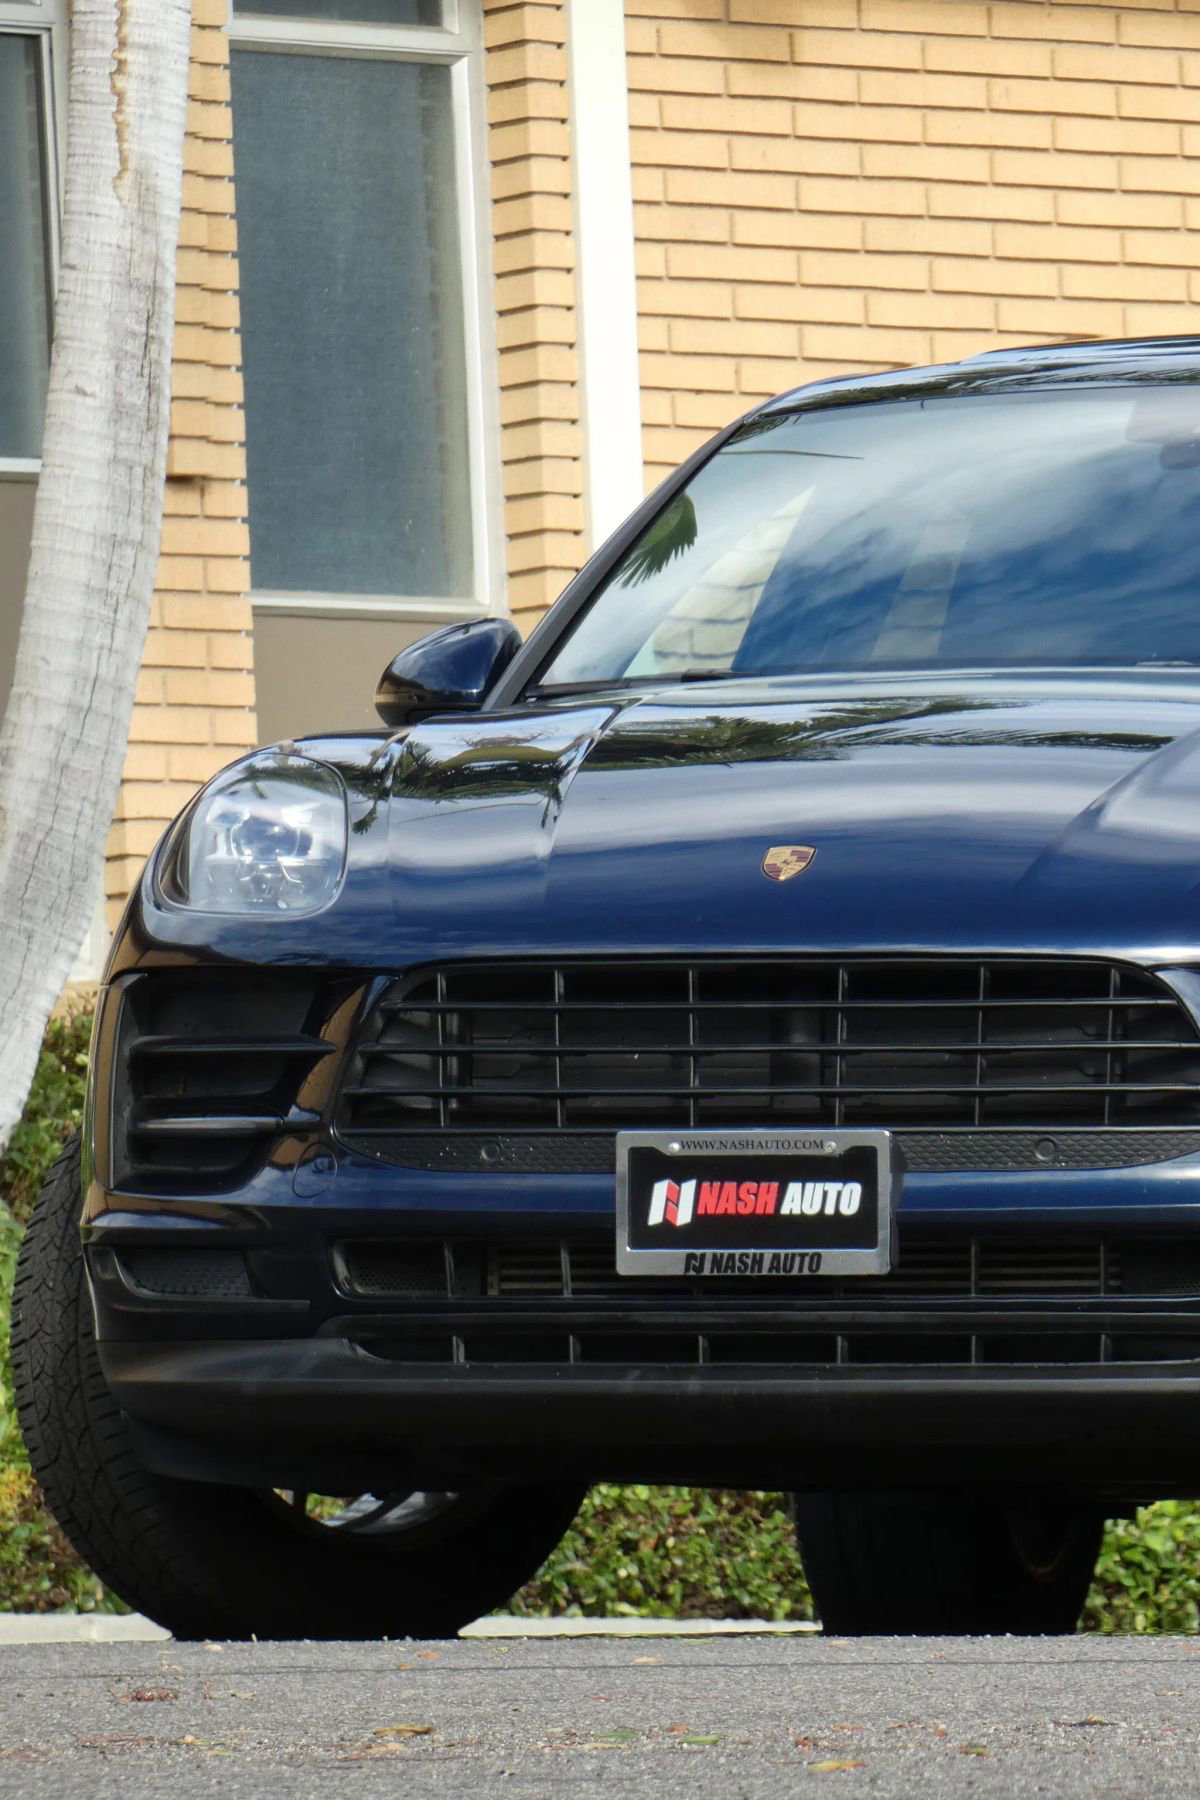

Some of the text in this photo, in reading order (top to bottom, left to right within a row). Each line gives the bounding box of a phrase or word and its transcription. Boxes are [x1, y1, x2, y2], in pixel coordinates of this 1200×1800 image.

[681, 1139, 823, 1150] WWW.NASHAUTO.COM
[697, 1182, 779, 1215] NASH
[781, 1182, 862, 1215] AUTO
[710, 1252, 764, 1273] NASH
[768, 1252, 822, 1274] AUTO
